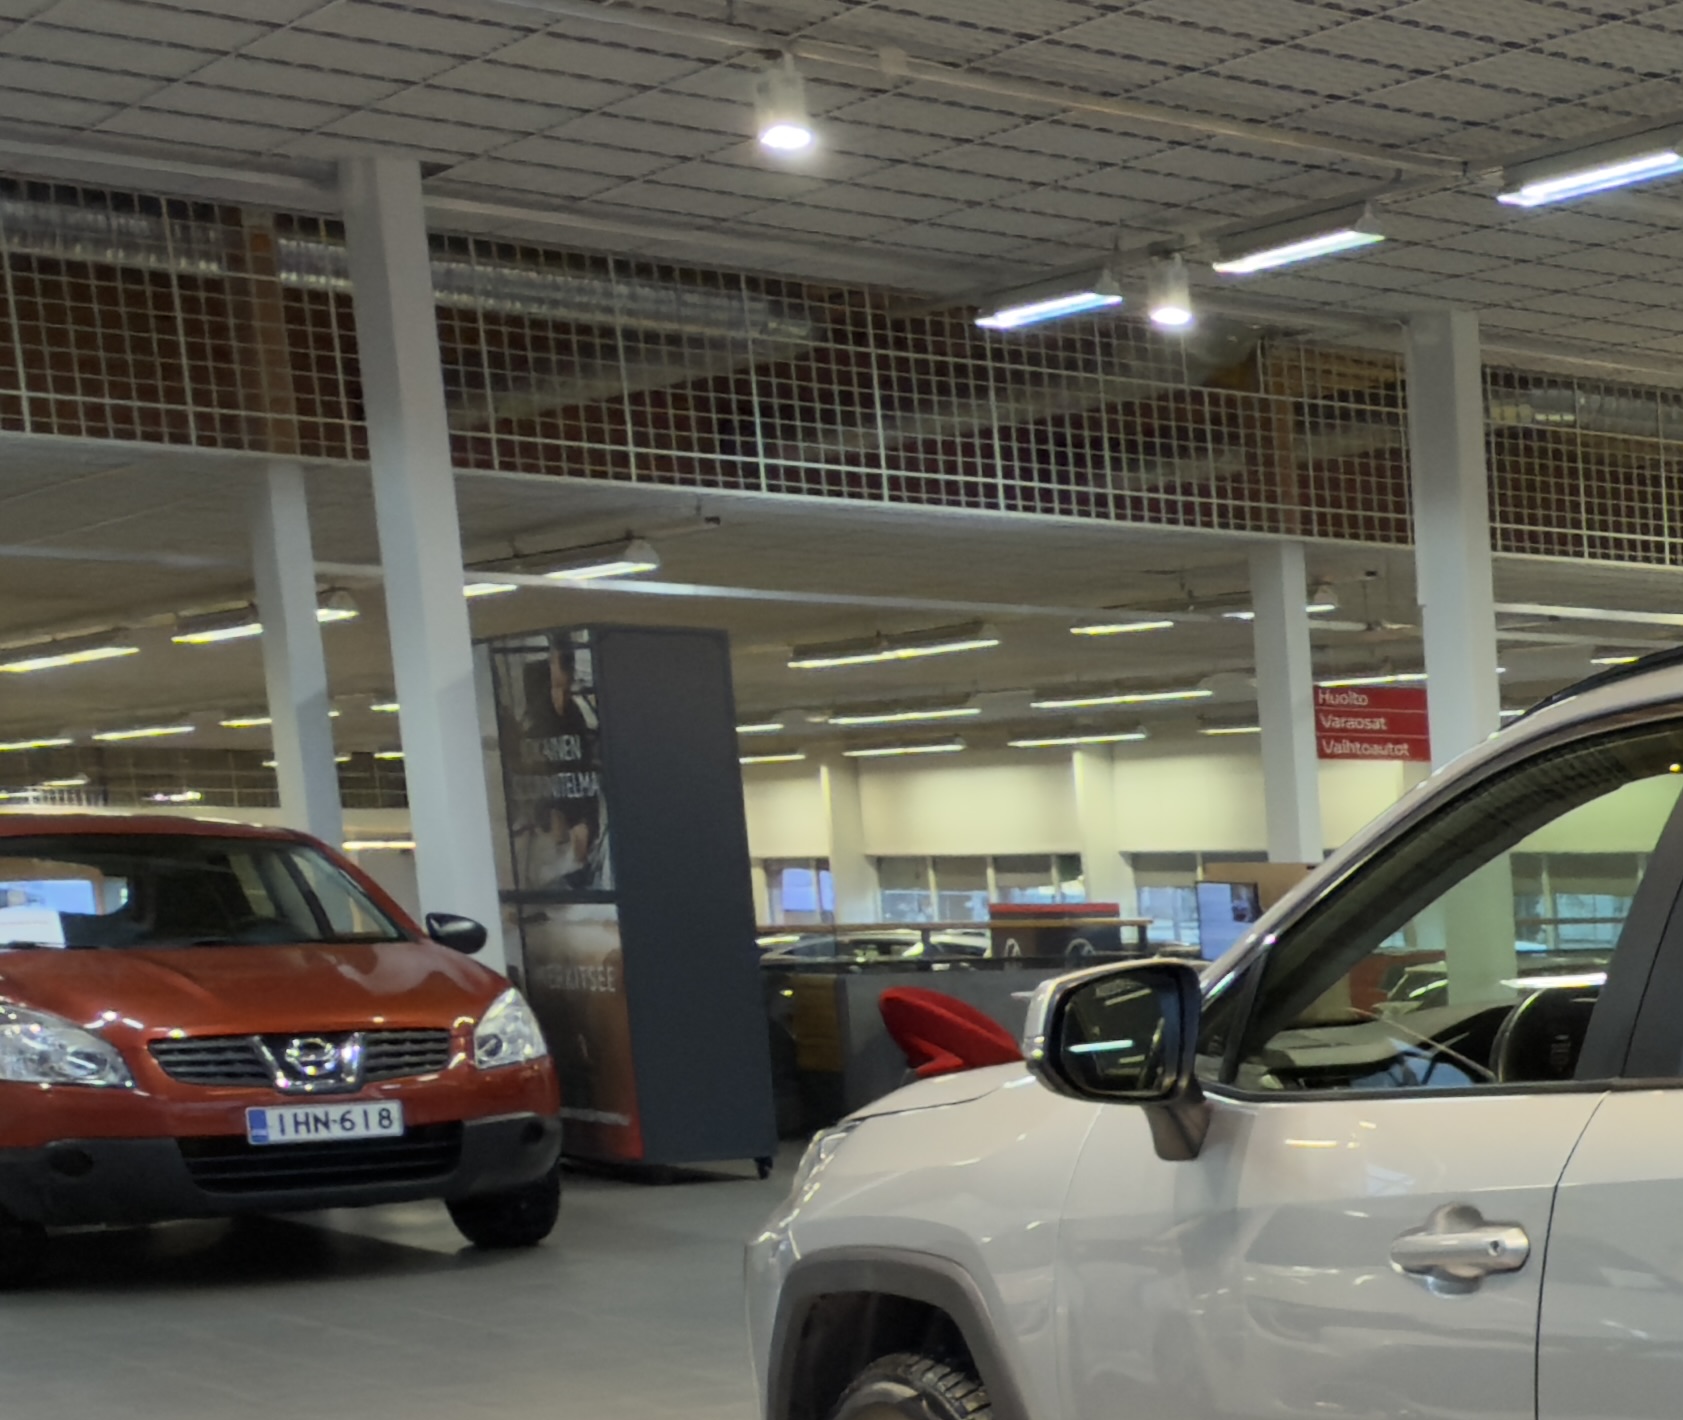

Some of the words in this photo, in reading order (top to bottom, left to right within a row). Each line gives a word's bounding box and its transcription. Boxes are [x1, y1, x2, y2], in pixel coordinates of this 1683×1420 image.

[1317, 689, 1369, 706] Huolto
[1319, 713, 1388, 730] Varaosat
[1321, 738, 1410, 756] Vaihtoautot
[278, 1107, 394, 1137] IHN-618
